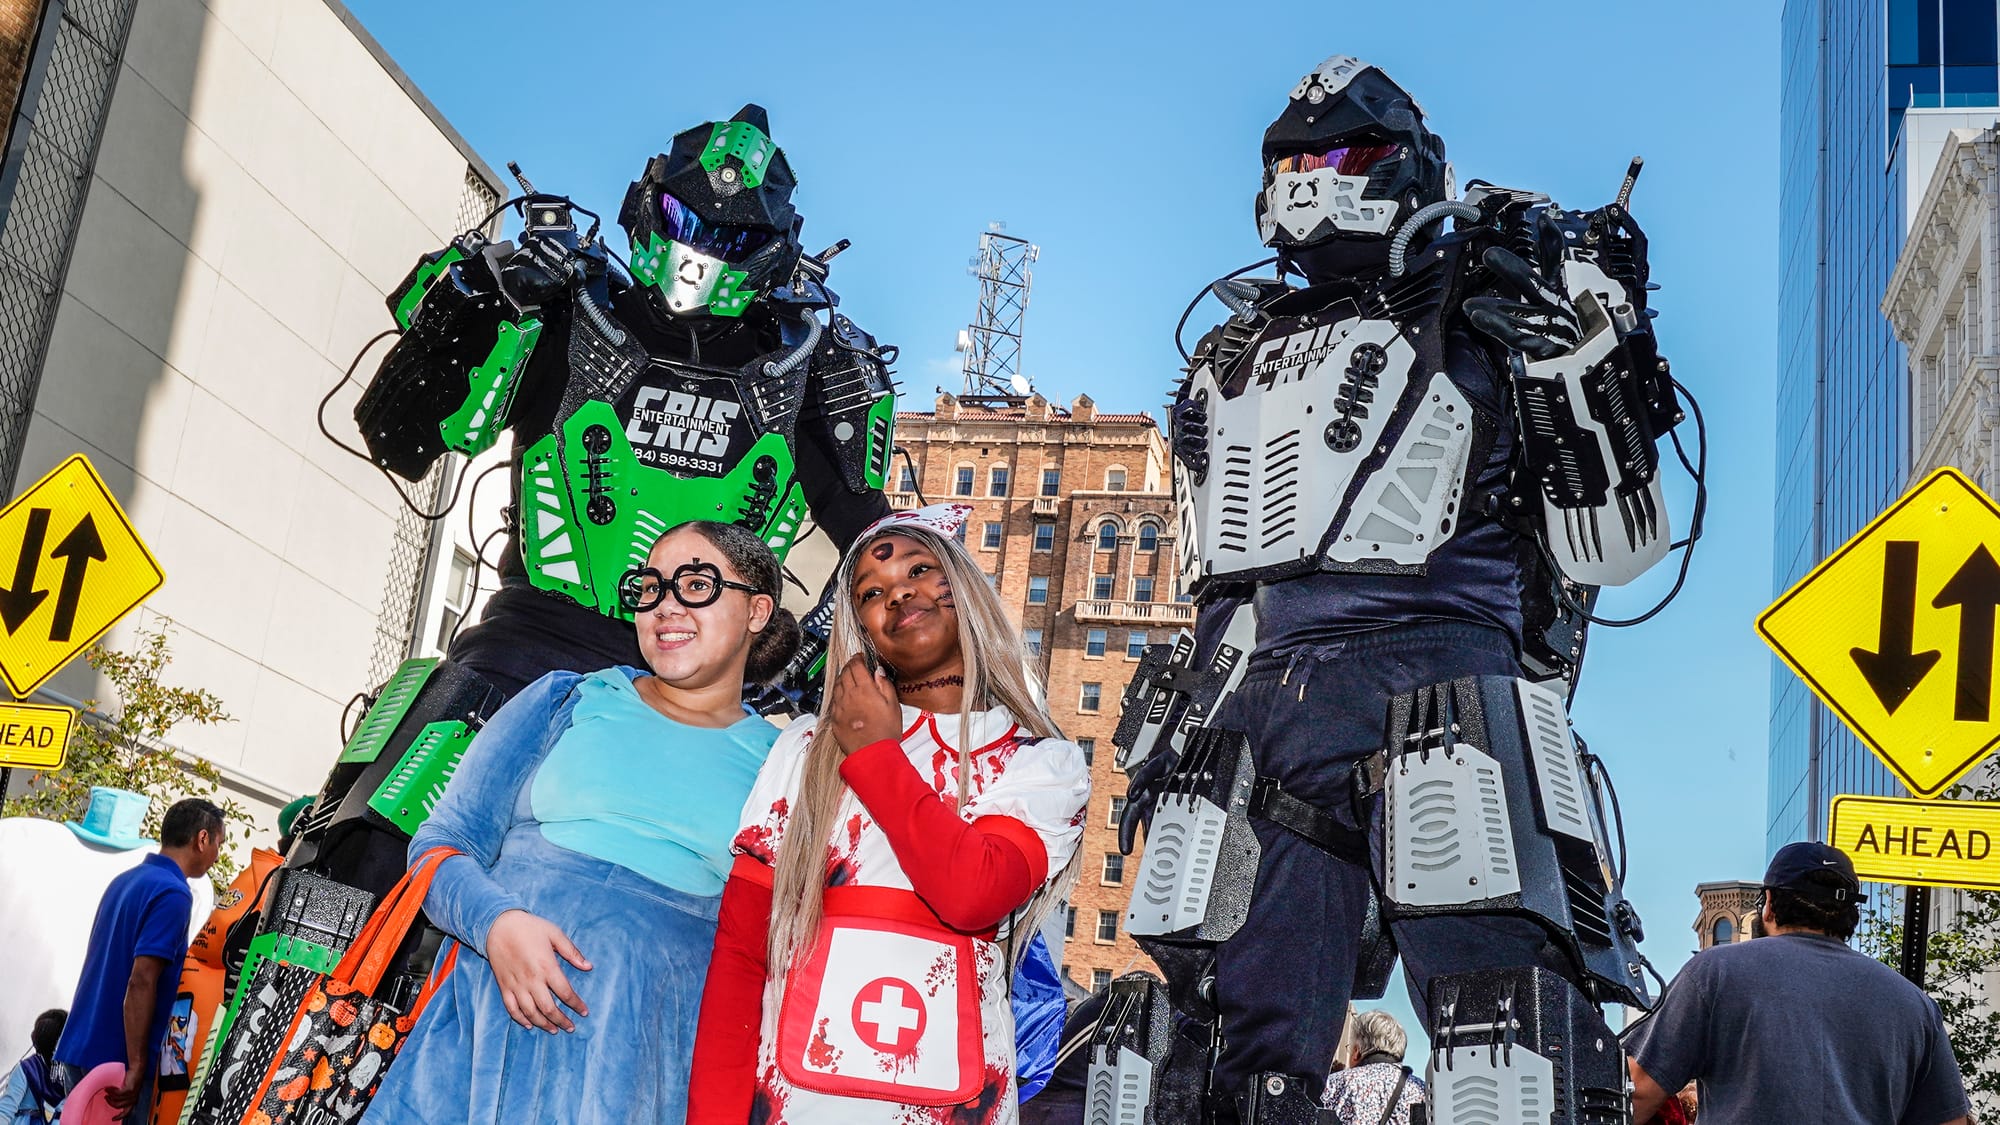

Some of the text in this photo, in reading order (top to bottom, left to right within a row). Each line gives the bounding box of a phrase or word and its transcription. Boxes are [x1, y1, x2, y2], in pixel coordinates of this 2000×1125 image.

[1252, 345, 1335, 376] ENTERTAINME
[626, 387, 740, 457] CRIS
[634, 409, 731, 435] ENTERTAINMENT
[632, 447, 723, 473] 84) 598-3331
[1854, 823, 1991, 860] AHEAD
